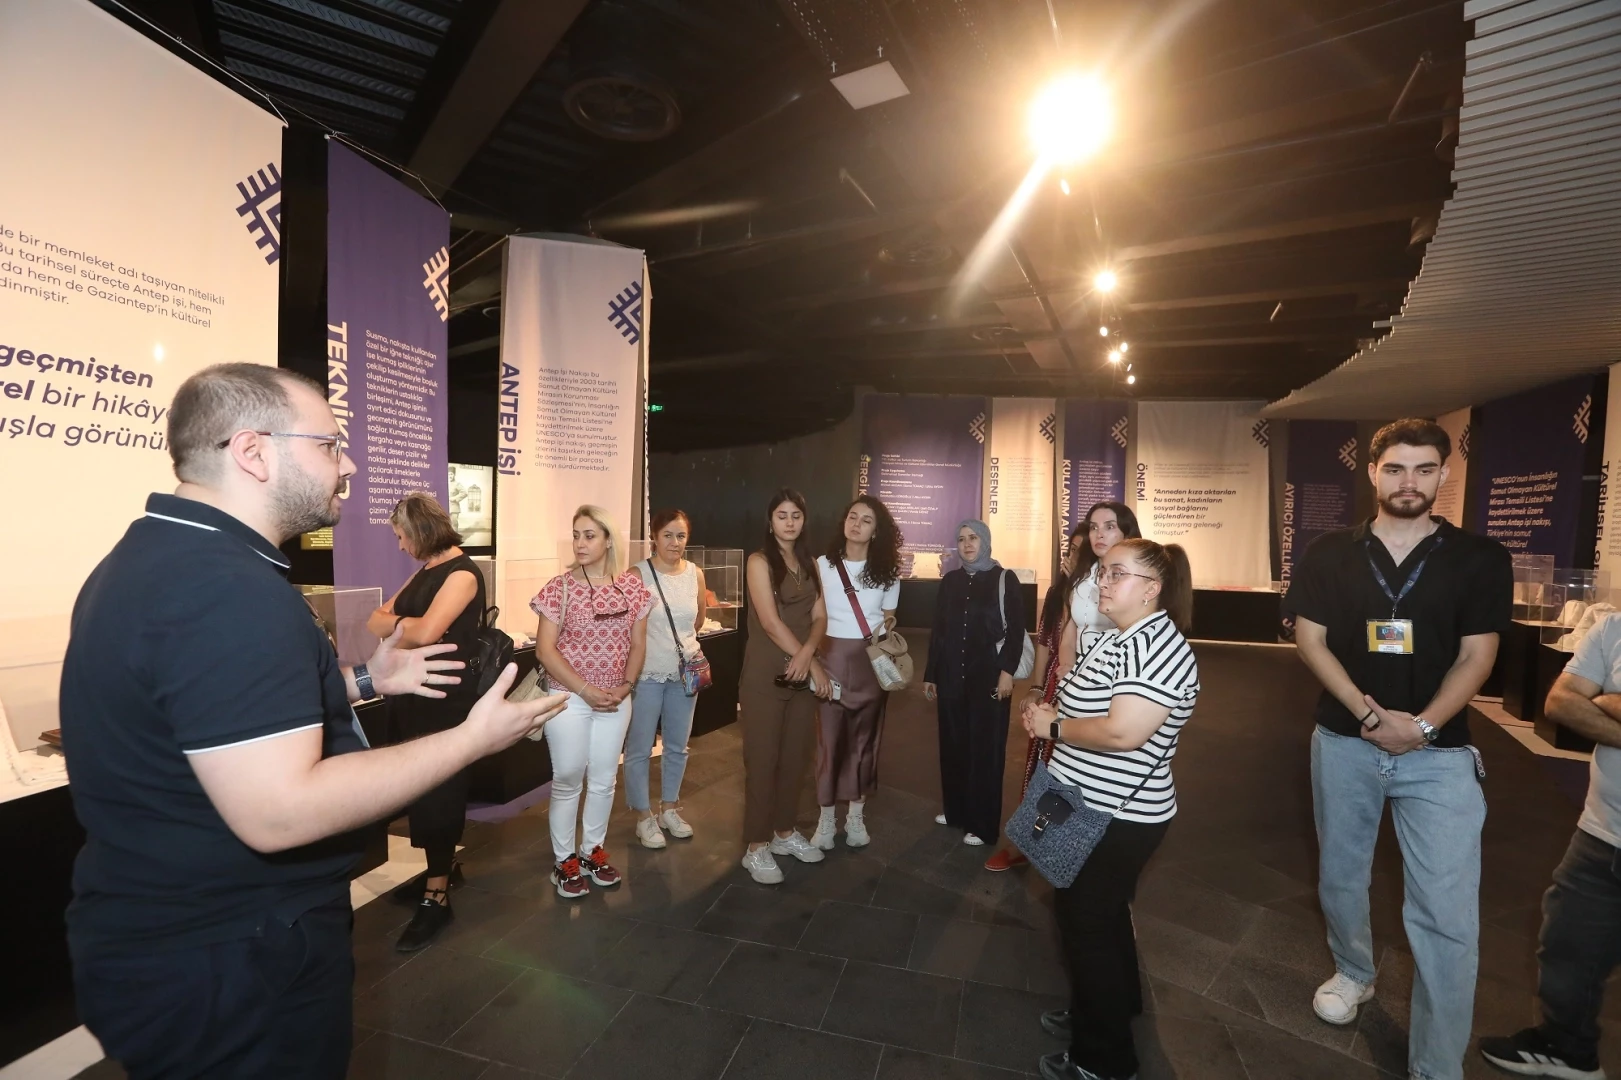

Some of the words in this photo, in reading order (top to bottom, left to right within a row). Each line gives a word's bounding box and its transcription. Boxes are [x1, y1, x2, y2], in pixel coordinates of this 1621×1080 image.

[2, 261, 22, 275] da
[28, 267, 60, 286] hem
[66, 280, 83, 292] de
[88, 286, 167, 316] Gaziantep'in
[172, 306, 210, 328] kültürel
[19, 249, 76, 274] tarihsel
[81, 268, 129, 290] süreçte
[133, 285, 169, 303] Antep
[173, 298, 186, 309] işi,
[190, 301, 211, 315] hem
[20, 231, 40, 246] bir
[45, 242, 115, 271] memleket
[118, 267, 138, 279] adı
[141, 272, 185, 293] taşıyan
[189, 287, 224, 305] nitelikli
[0, 344, 153, 388] geçmişten
[0, 380, 35, 400] el
[42, 383, 85, 407] bir
[92, 391, 169, 424] hikây
[501, 361, 520, 442] ANTEP
[860, 454, 870, 487] SERGİ
[990, 458, 999, 514] DESENLER
[1062, 459, 1072, 517] KULLANIM
[1136, 463, 1148, 501] ÖNEMİ
[1193, 522, 1223, 530] geleneği
[1284, 482, 1295, 525] AYIRICI
[1596, 460, 1610, 541] TARİHSEL
[1060, 519, 1070, 574] ALANL
[1281, 528, 1296, 599] ÖZELLİKLER
